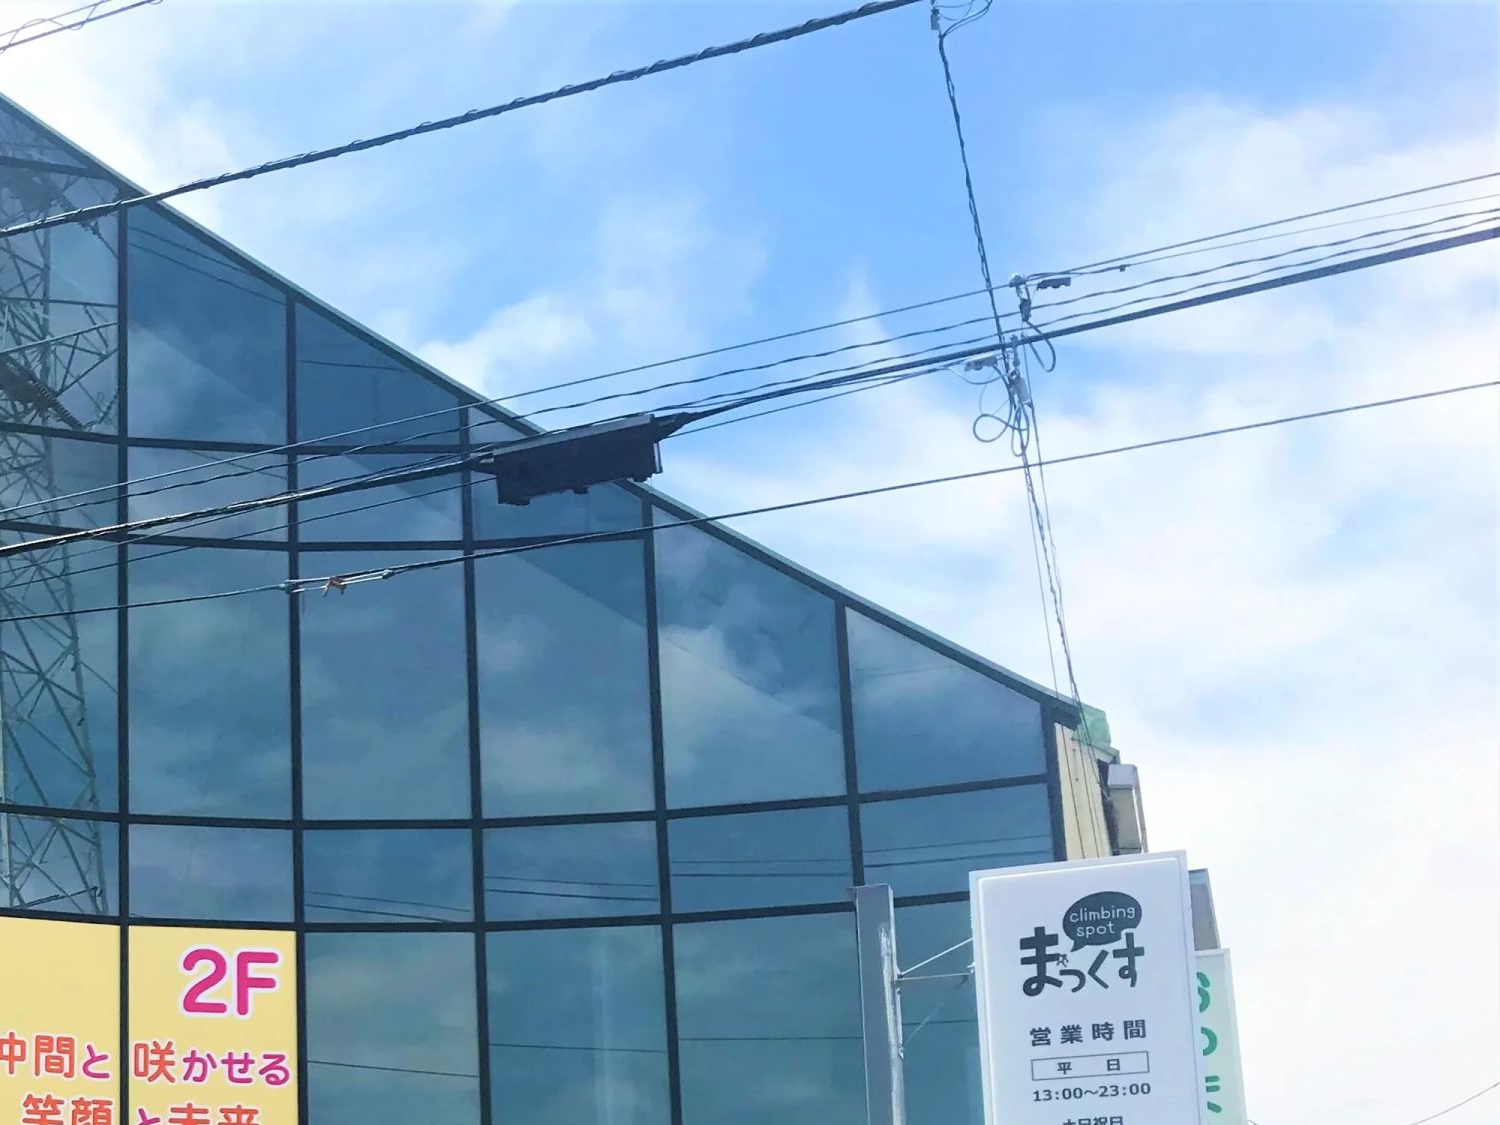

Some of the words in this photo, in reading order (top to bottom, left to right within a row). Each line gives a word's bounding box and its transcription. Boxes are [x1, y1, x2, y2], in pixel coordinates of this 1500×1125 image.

[1069, 905, 1136, 924] climbing
[1076, 920, 1116, 939] spot
[1019, 926, 1145, 997] まっくす
[180, 947, 280, 1016] 2F
[1029, 1019, 1147, 1047] 営業時間
[134, 1041, 292, 1086] 咲かせる
